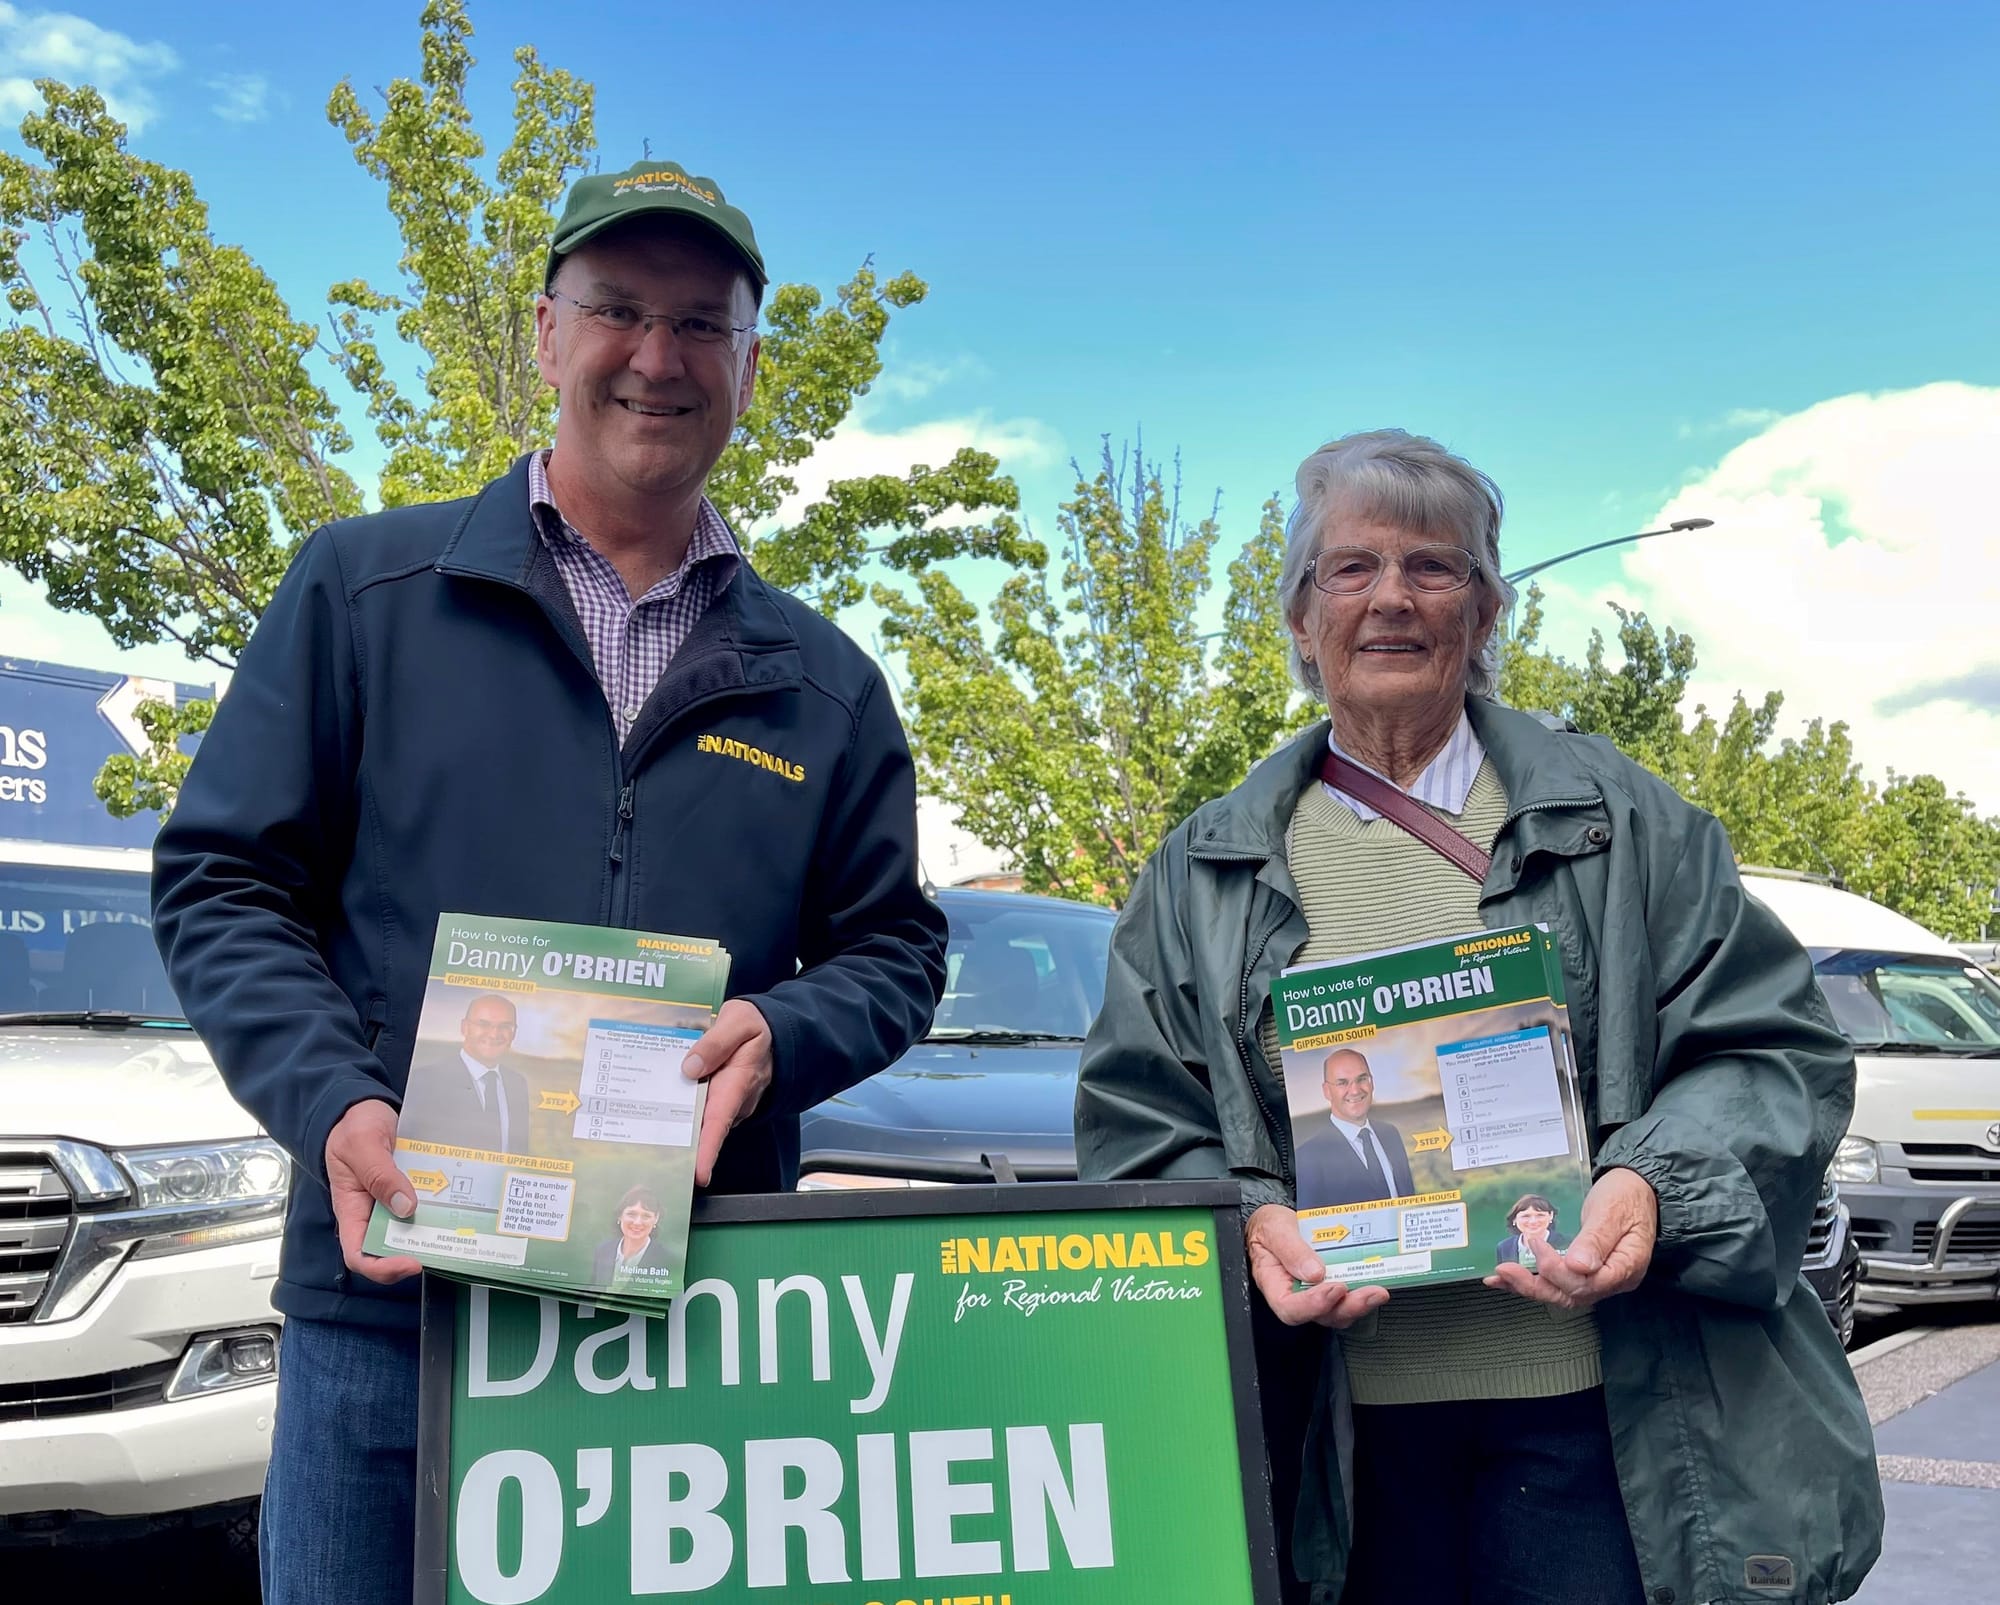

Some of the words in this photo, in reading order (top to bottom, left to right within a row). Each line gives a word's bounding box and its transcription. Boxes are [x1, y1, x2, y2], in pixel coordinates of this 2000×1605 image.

[705, 734, 805, 782] NATIONALS
[451, 927, 480, 940] How
[484, 931, 497, 942] to
[501, 933, 529, 945] vote
[532, 935, 550, 947] for
[1457, 931, 1532, 955] NATIONALS
[640, 939, 713, 955] NATIONALS
[447, 941, 535, 978] Danny
[542, 951, 666, 988] O'BRIEN
[447, 975, 501, 988] GIPPSLAND
[502, 982, 534, 992] SOUTH
[1283, 987, 1310, 1002] How
[1313, 985, 1326, 996] to
[1328, 980, 1355, 993] vote
[1357, 975, 1374, 987] for
[1286, 996, 1366, 1032] Danny
[1373, 965, 1495, 1014] O'BRIEN
[1296, 1033, 1344, 1050] GIPPSLAND
[1346, 1027, 1375, 1041] SOUTH
[1420, 1137, 1440, 1146] STEP
[409, 1142, 432, 1153] HOW
[432, 1145, 447, 1155] TO
[448, 1147, 472, 1159] VOTE
[474, 1151, 485, 1160] IN
[487, 1153, 505, 1163] THE
[506, 1157, 537, 1167] UPPER
[539, 1160, 571, 1171] HOUSE
[411, 1175, 435, 1186] STEP
[436, 1178, 444, 1187] 2
[511, 1177, 531, 1187] Place
[539, 1182, 568, 1191] number
[534, 1192, 548, 1200] Box
[1308, 1208, 1329, 1217] HOW
[1331, 1206, 1343, 1214] TO
[1345, 1204, 1366, 1213] VOTE
[1379, 1200, 1396, 1208] THE
[1398, 1196, 1427, 1206] UPPER
[1428, 1192, 1458, 1202] HOUSE
[505, 1214, 519, 1222] any
[520, 1215, 534, 1224] box
[535, 1211, 564, 1220] number
[503, 1222, 516, 1230] the
[517, 1223, 532, 1231] line
[1316, 1230, 1333, 1239] STEP
[1338, 1229, 1344, 1237] 2
[407, 1238, 420, 1247] The
[420, 1241, 453, 1251] Nationals
[436, 1235, 478, 1246] REMEMBER
[941, 1238, 957, 1274] THE
[957, 1231, 1209, 1274] NATIONALS
[620, 1265, 648, 1275] Melina
[649, 1267, 669, 1277] Bath
[954, 1282, 992, 1323] for
[1002, 1276, 1103, 1317] Regional
[1110, 1275, 1203, 1303] Victoria
[468, 1272, 915, 1414] Danny
[455, 1422, 1115, 1605] O'BRIEN
